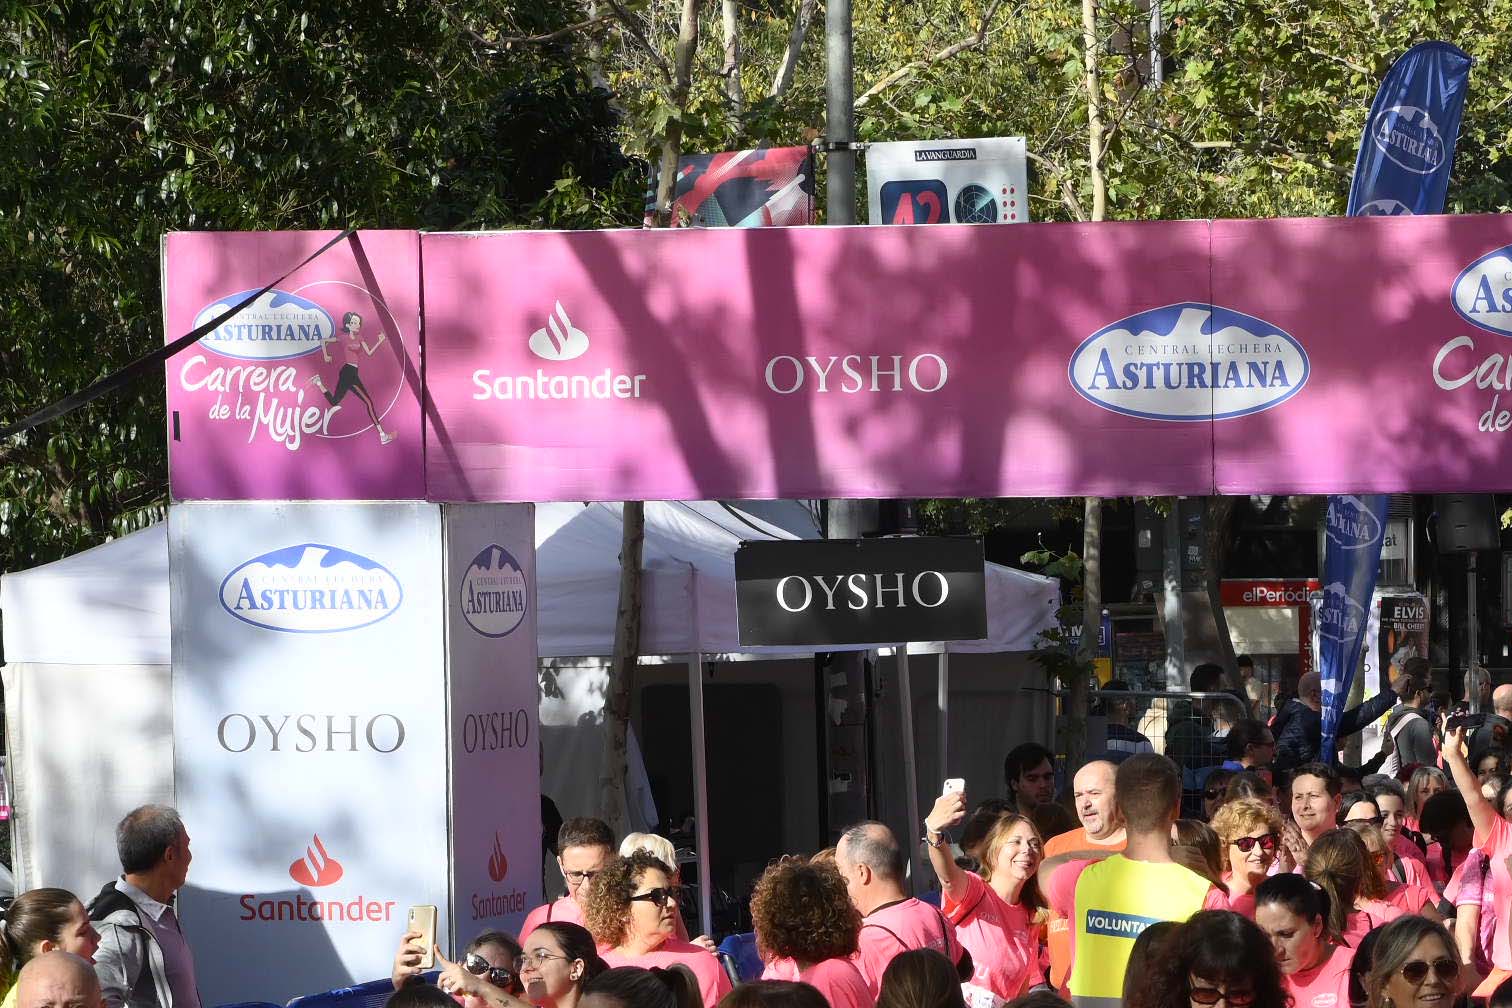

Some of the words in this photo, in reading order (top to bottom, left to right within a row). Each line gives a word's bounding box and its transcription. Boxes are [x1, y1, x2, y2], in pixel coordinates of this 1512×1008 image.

[204, 314, 323, 342] ASTURIANA
[1124, 344, 1200, 356] CENTRAL
[1208, 342, 1283, 355] LECHERA
[180, 354, 300, 393] Carrera
[472, 367, 647, 402] Santander
[764, 353, 949, 395] OYSHO
[1088, 347, 1292, 391] ASTURIANA
[208, 394, 231, 420] de
[235, 392, 251, 420] la
[248, 387, 343, 451] Mujer
[1478, 394, 1512, 432] de
[233, 578, 390, 612] ASTURIANA
[465, 578, 524, 615] ASTURIANA
[776, 569, 950, 613] OYSHO
[1394, 606, 1424, 619] ELVIS
[217, 712, 406, 753] OYSHO
[463, 707, 530, 754] OYSHO
[239, 893, 396, 923] Santander
[471, 888, 527, 921] Santander
